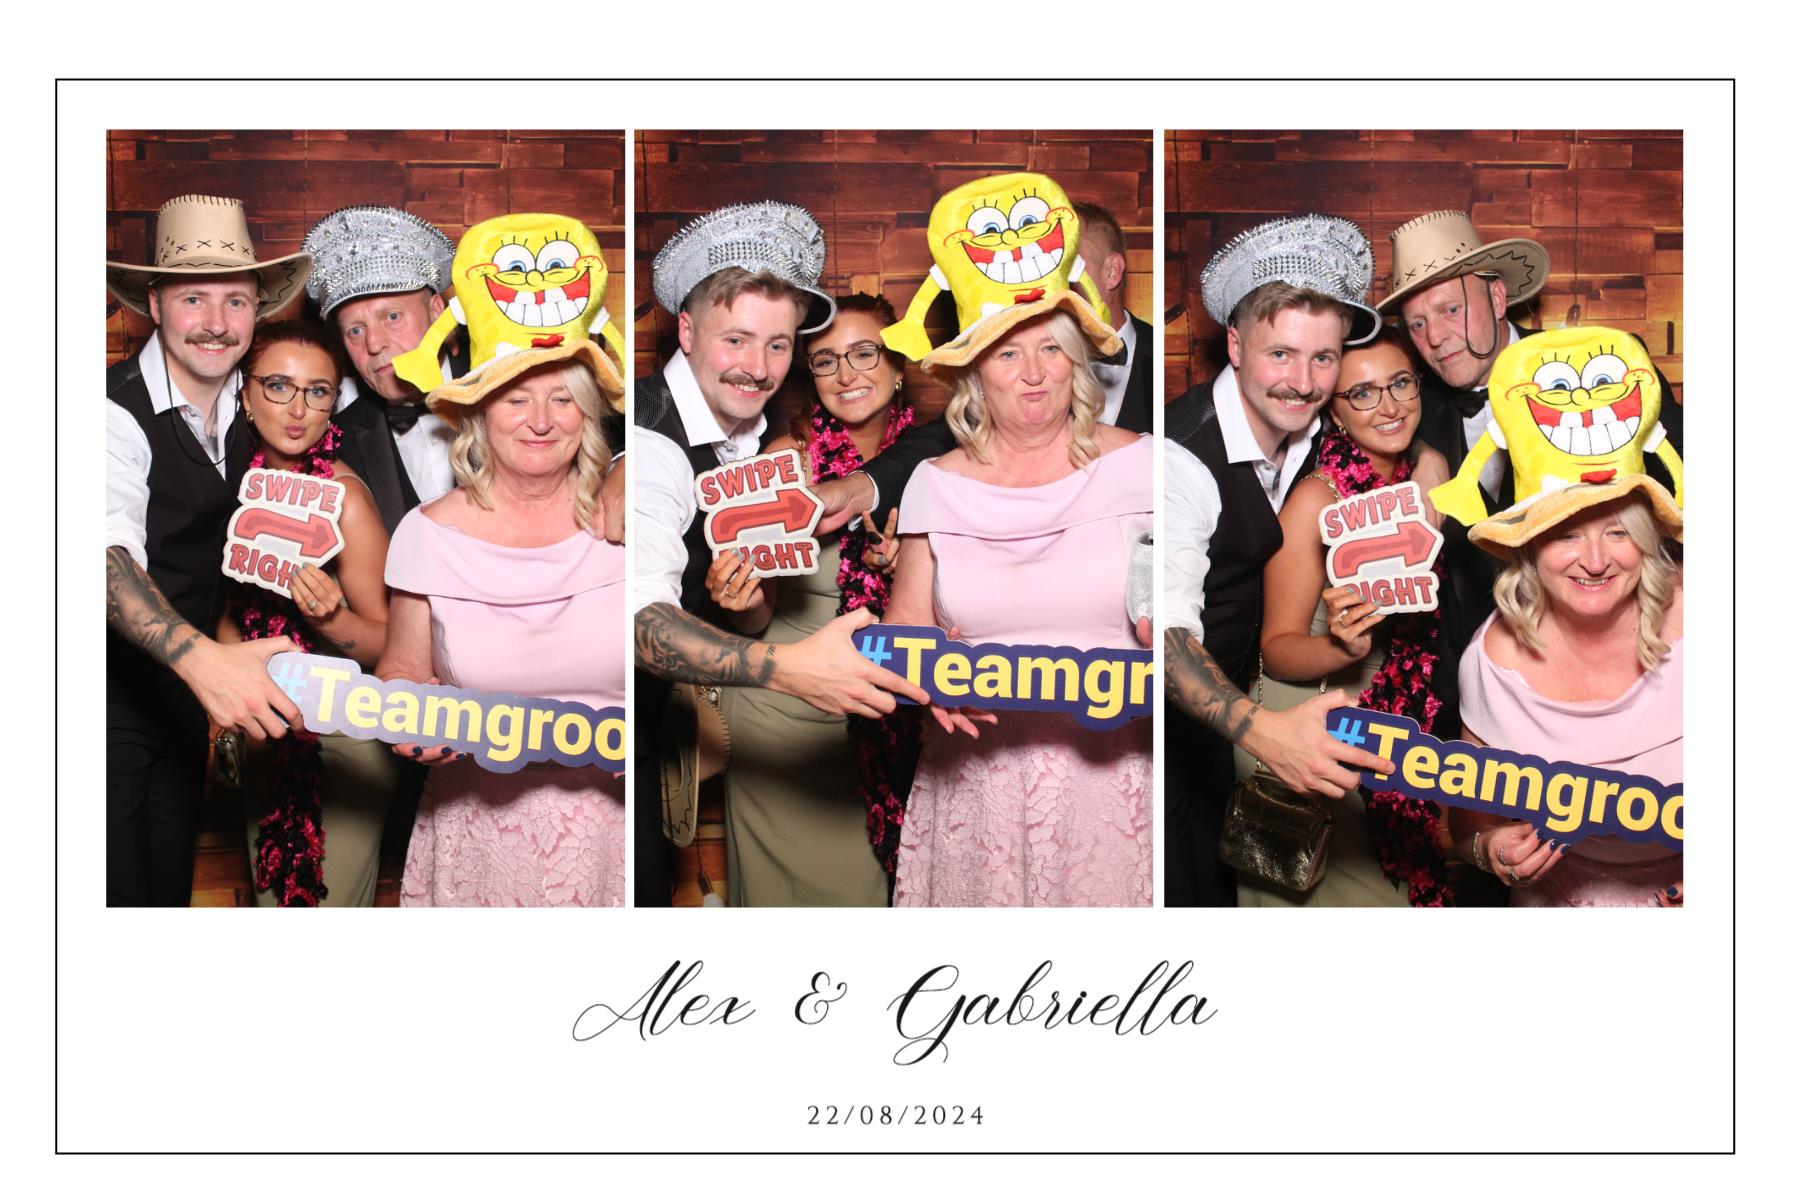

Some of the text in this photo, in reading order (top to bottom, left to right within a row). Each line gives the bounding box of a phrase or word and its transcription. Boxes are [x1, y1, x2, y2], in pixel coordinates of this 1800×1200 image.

[245, 472, 340, 514] SWIPE
[700, 453, 799, 506] SWIPE
[1324, 486, 1419, 539] SWIPE
[228, 543, 303, 592] RIGH
[718, 541, 814, 572] IGHT
